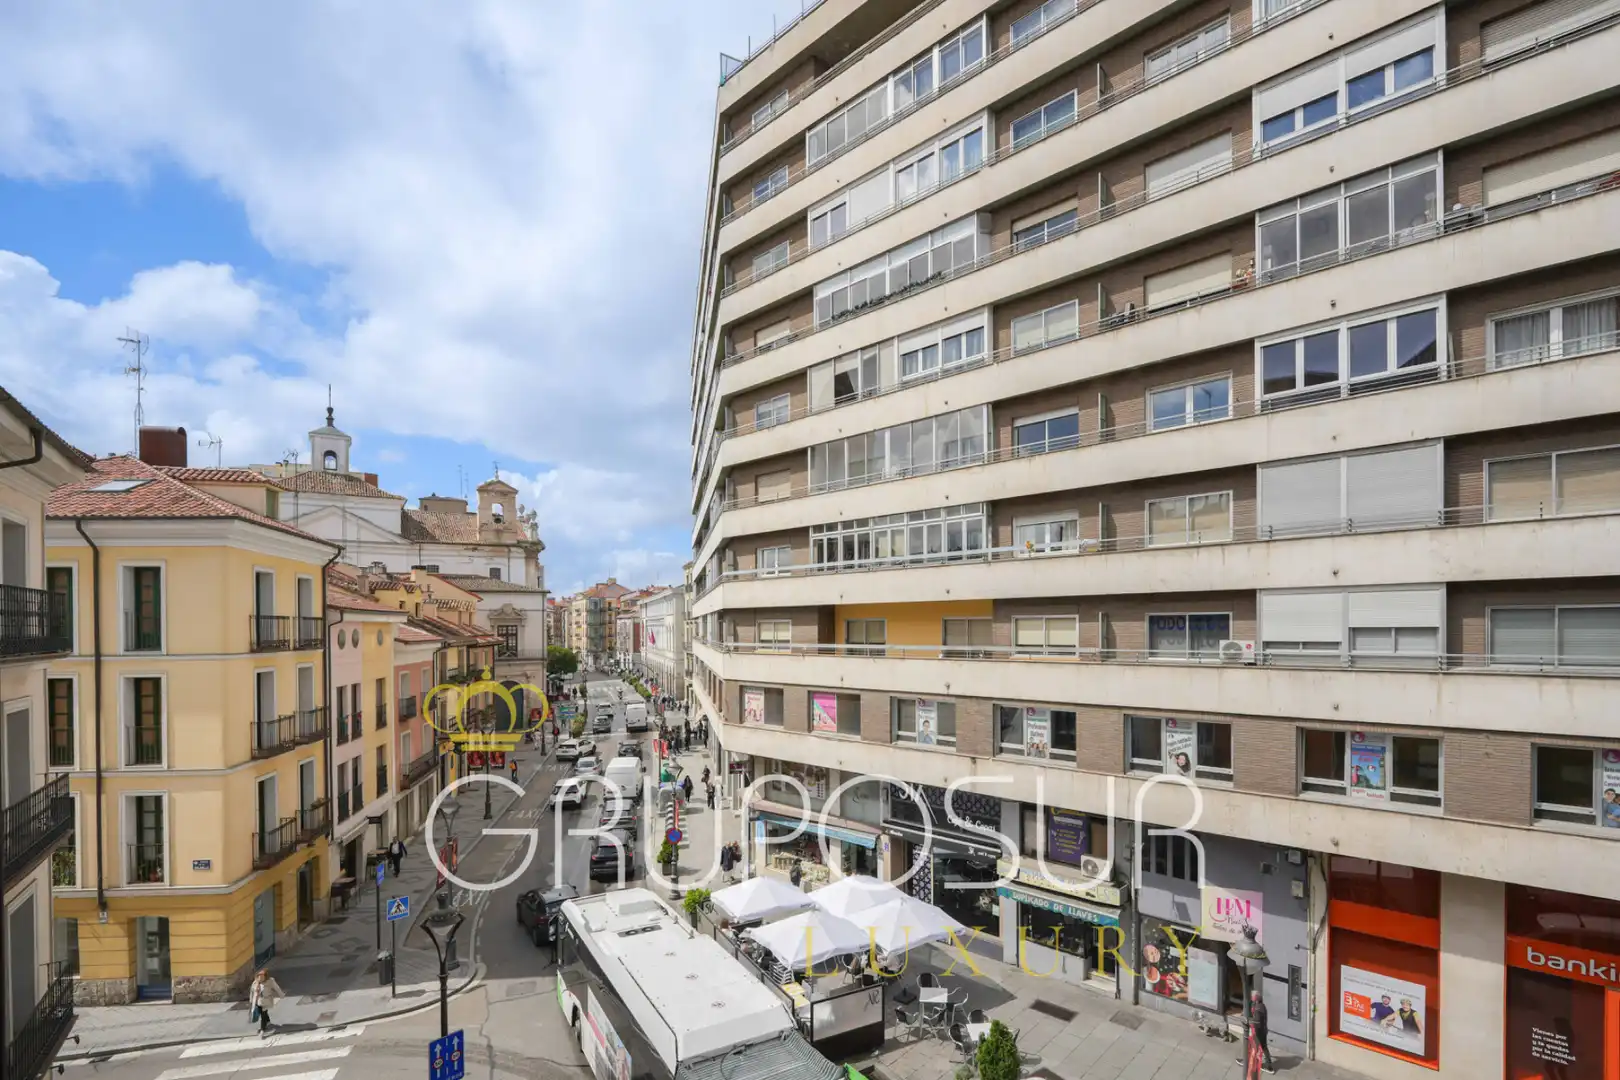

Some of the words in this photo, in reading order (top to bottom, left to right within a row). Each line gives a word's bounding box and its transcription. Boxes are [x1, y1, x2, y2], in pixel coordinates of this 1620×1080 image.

[1012, 891, 1049, 908] DUPLICADO
[1053, 903, 1064, 911] DE
[1068, 906, 1098, 922] LLAVES
[1527, 946, 1620, 982] banki
[1543, 1037, 1569, 1047] cuentas
[1545, 1044, 1570, 1053] quedas
[1552, 1051, 1576, 1061] calidad
